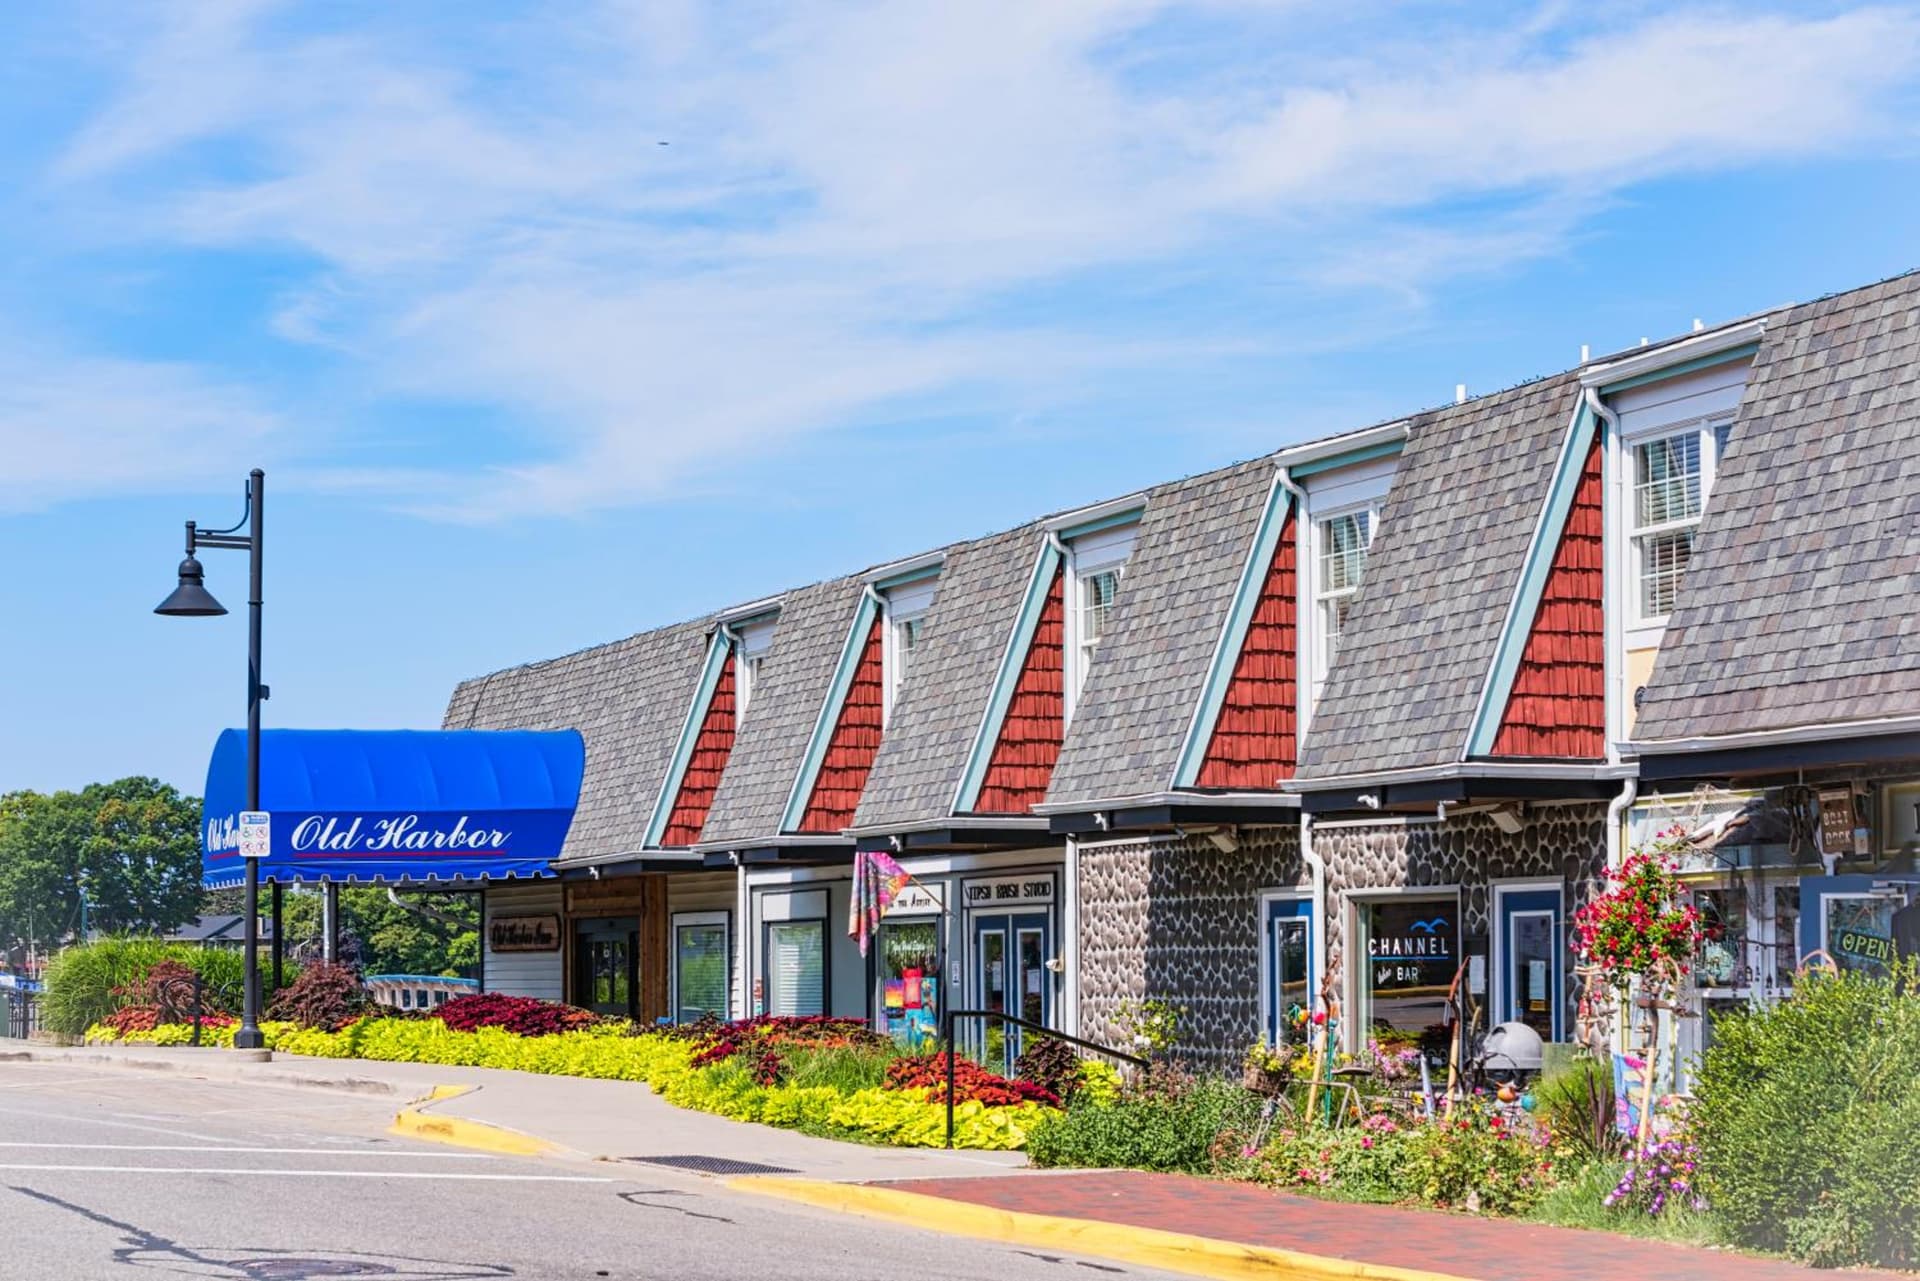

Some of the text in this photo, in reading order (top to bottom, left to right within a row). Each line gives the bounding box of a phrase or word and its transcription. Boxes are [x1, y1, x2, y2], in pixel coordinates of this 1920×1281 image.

[291, 814, 512, 850] Old Harbor
[1825, 830, 1851, 845] DOCK
[1368, 937, 1449, 956] CHANNEL
[1842, 933, 1890, 961] OPEN
[1397, 966, 1419, 981] BAR
